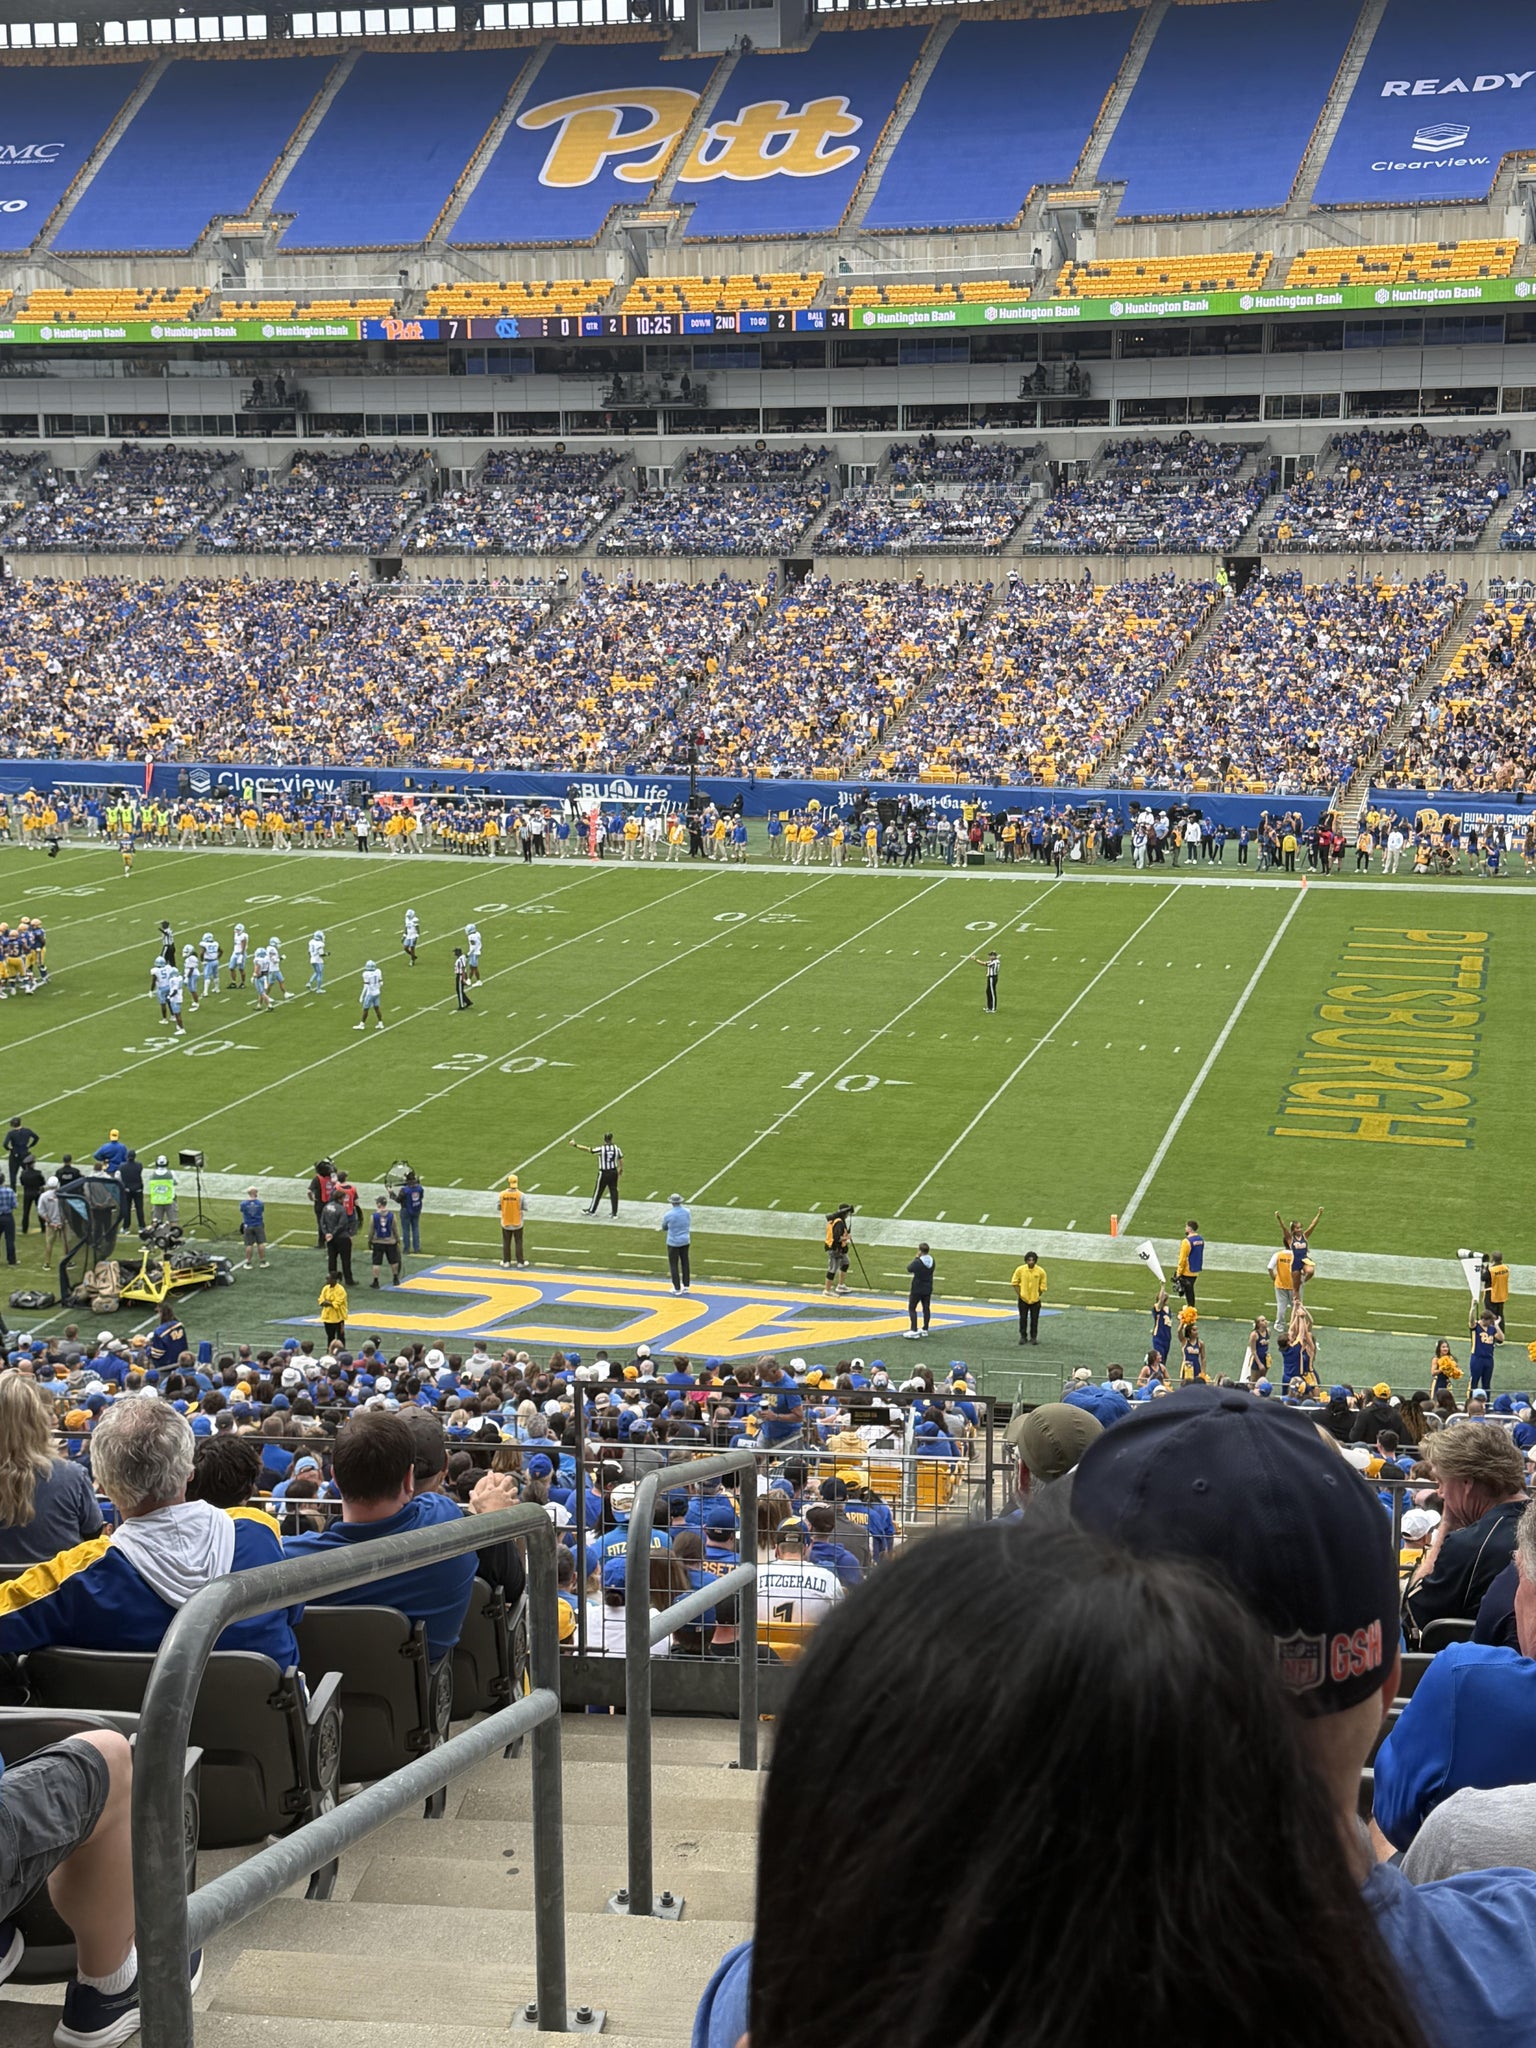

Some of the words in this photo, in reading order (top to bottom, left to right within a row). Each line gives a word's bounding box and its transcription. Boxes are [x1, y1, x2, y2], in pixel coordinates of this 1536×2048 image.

[1381, 70, 1536, 97] READY
[516, 86, 863, 188] Pitt
[1255, 296, 1312, 309] Huntington
[1314, 292, 1343, 305] Bank
[1392, 289, 1452, 302] Huntington
[1453, 286, 1482, 298] Bank
[999, 307, 1053, 320] Huntington
[1054, 305, 1080, 317] Bank
[1125, 302, 1181, 315] Huntington
[1182, 299, 1208, 311] Bank
[609, 318, 617, 333] 2
[636, 316, 672, 335] 10:25
[715, 315, 735, 330] 2ND
[777, 314, 785, 328] 2
[831, 312, 845, 327] 34
[877, 312, 930, 325] Huntington
[931, 311, 956, 322] Bank
[0, 328, 15, 339] ank
[54, 328, 102, 340] Huntington
[103, 327, 126, 337] Bank
[164, 327, 213, 339] Huntington
[214, 326, 237, 337] Bank
[276, 326, 325, 338] Huntington
[325, 325, 348, 336] Bank
[381, 319, 424, 340] Pitt
[449, 321, 458, 339] 7
[561, 318, 569, 336] 0
[1268, 926, 1491, 1148] PITTSBURGH
[607, 1537, 661, 1557] FITZLD
[759, 1574, 826, 1594] FITZGERALD
[1330, 1618, 1383, 1682] GSH
